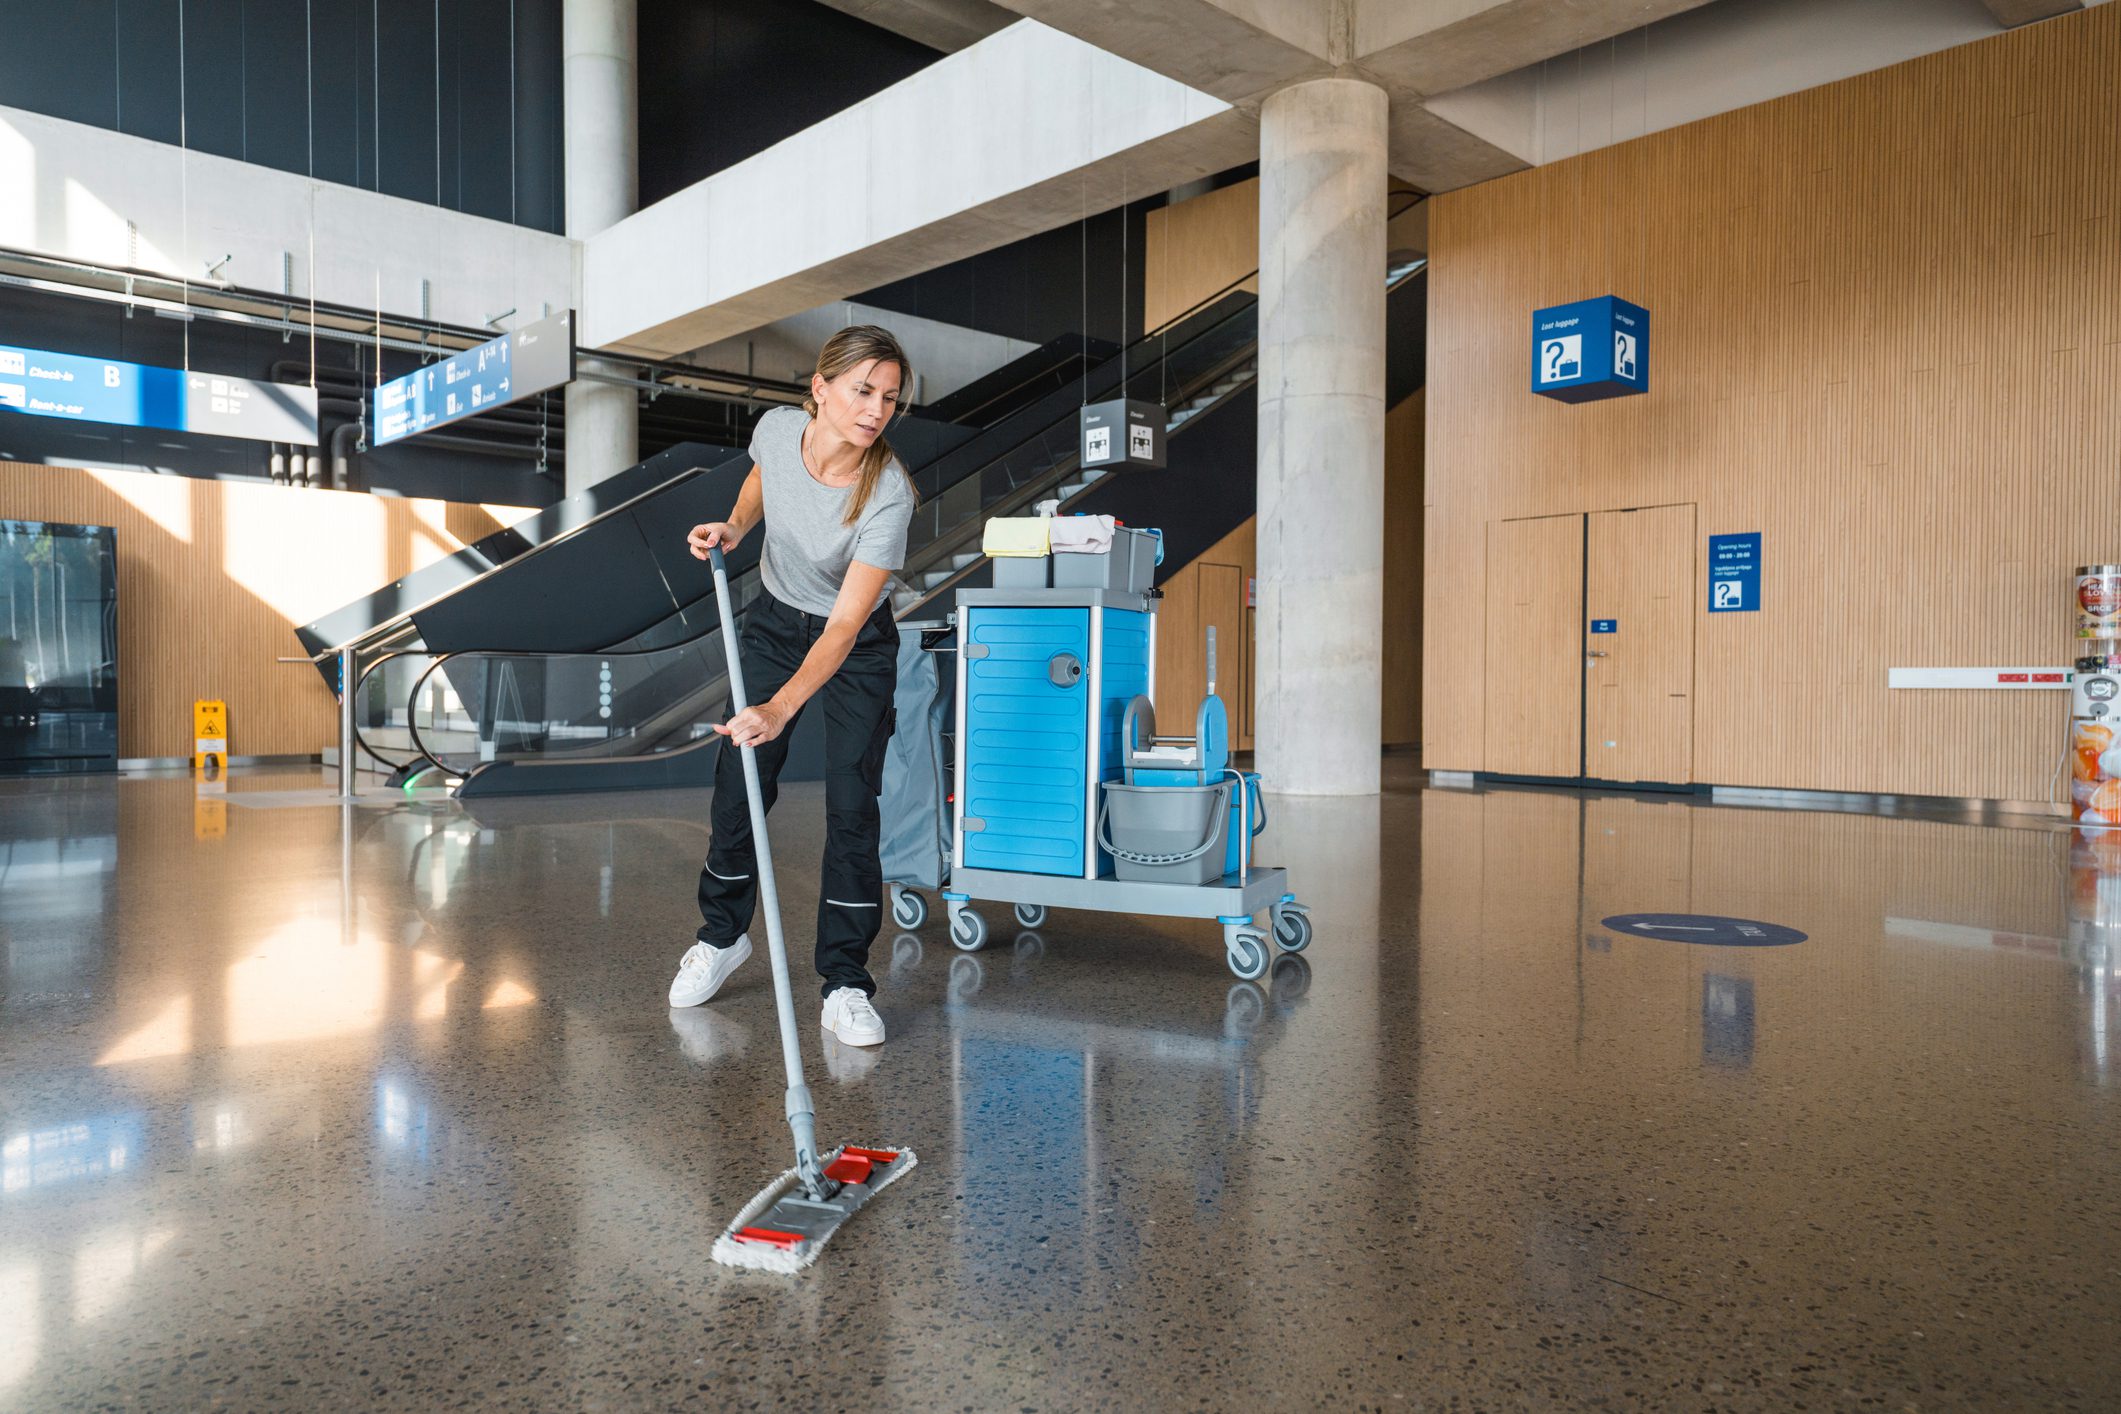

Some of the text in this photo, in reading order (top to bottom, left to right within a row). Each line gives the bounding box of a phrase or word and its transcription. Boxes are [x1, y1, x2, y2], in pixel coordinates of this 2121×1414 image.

[1541, 318, 1580, 330] Lost luggage
[478, 349, 486, 373] A
[29, 364, 121, 388] Check-in B
[29, 397, 85, 415] Rent-a-car
